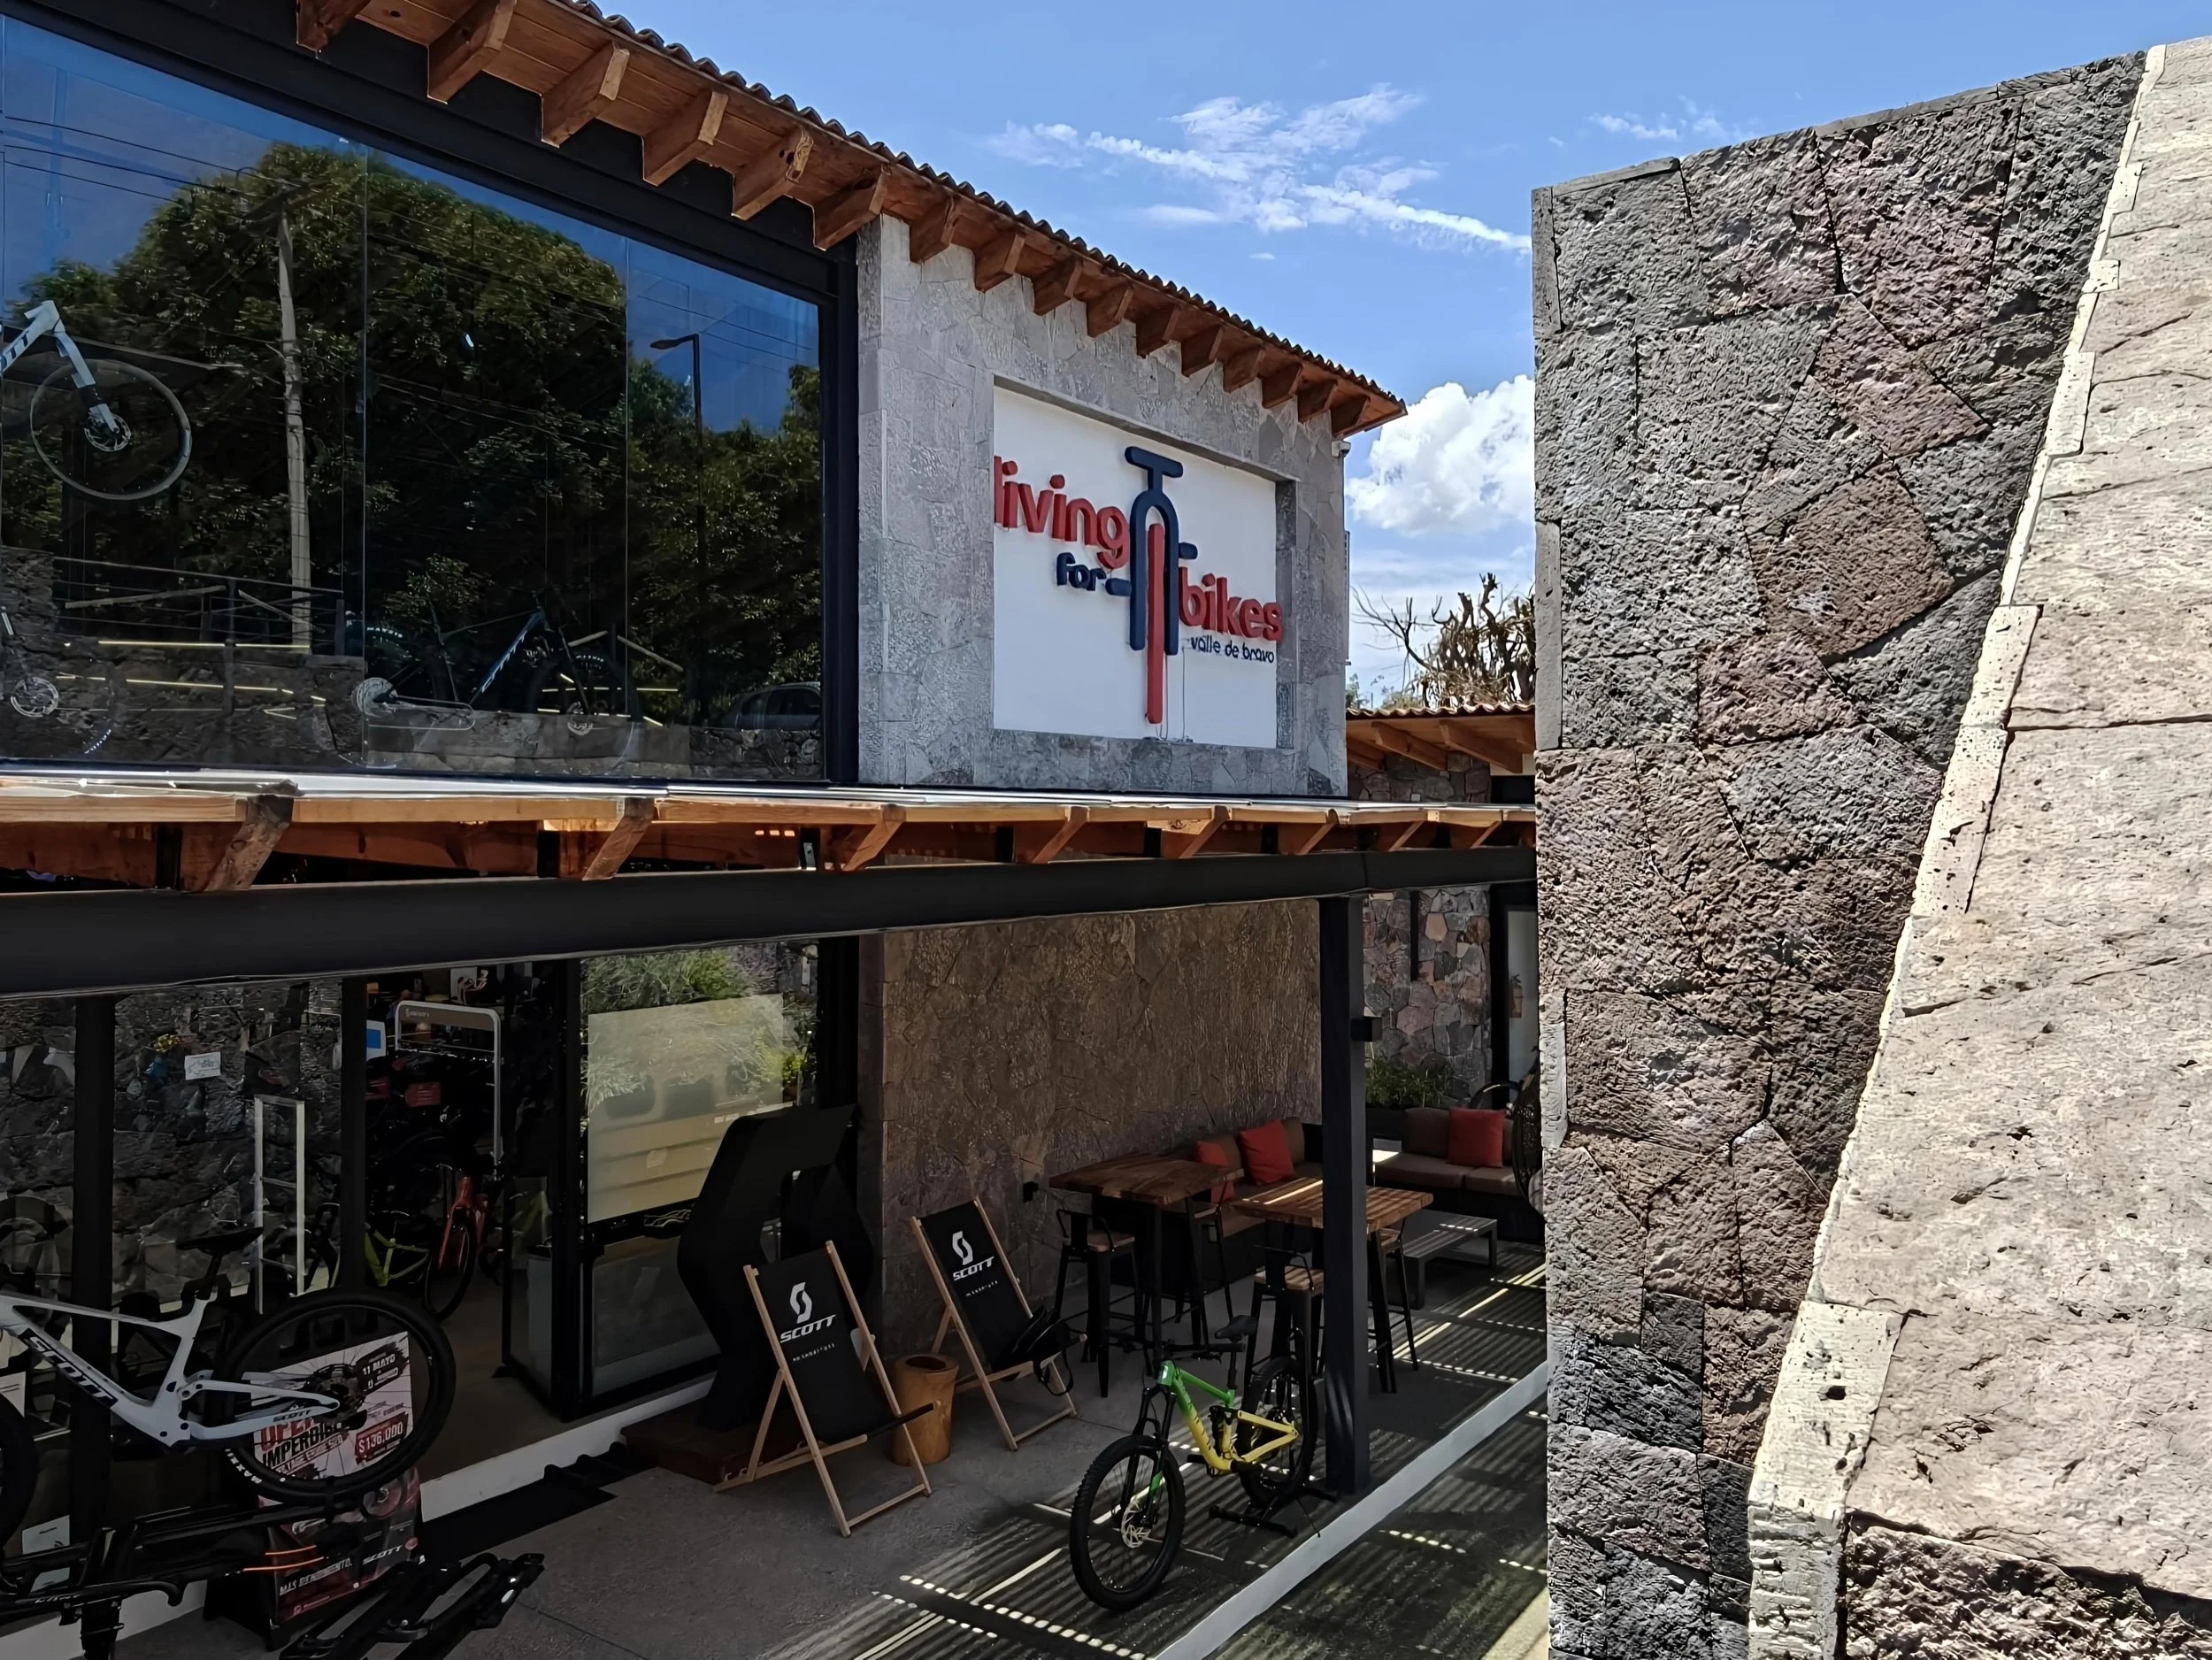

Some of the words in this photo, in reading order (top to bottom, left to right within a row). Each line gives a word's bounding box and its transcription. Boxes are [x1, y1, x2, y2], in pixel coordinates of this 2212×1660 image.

[994, 455, 1130, 570] living
[1056, 552, 1107, 591] for
[1179, 566, 1283, 642] bikes
[1191, 634, 1221, 654] valle
[1225, 640, 1240, 658] de
[1241, 643, 1275, 664] bravo
[952, 1256, 995, 1281] SCOTT
[780, 1313, 837, 1343] SCOTT
[24, 1335, 115, 1408] SCOTT
